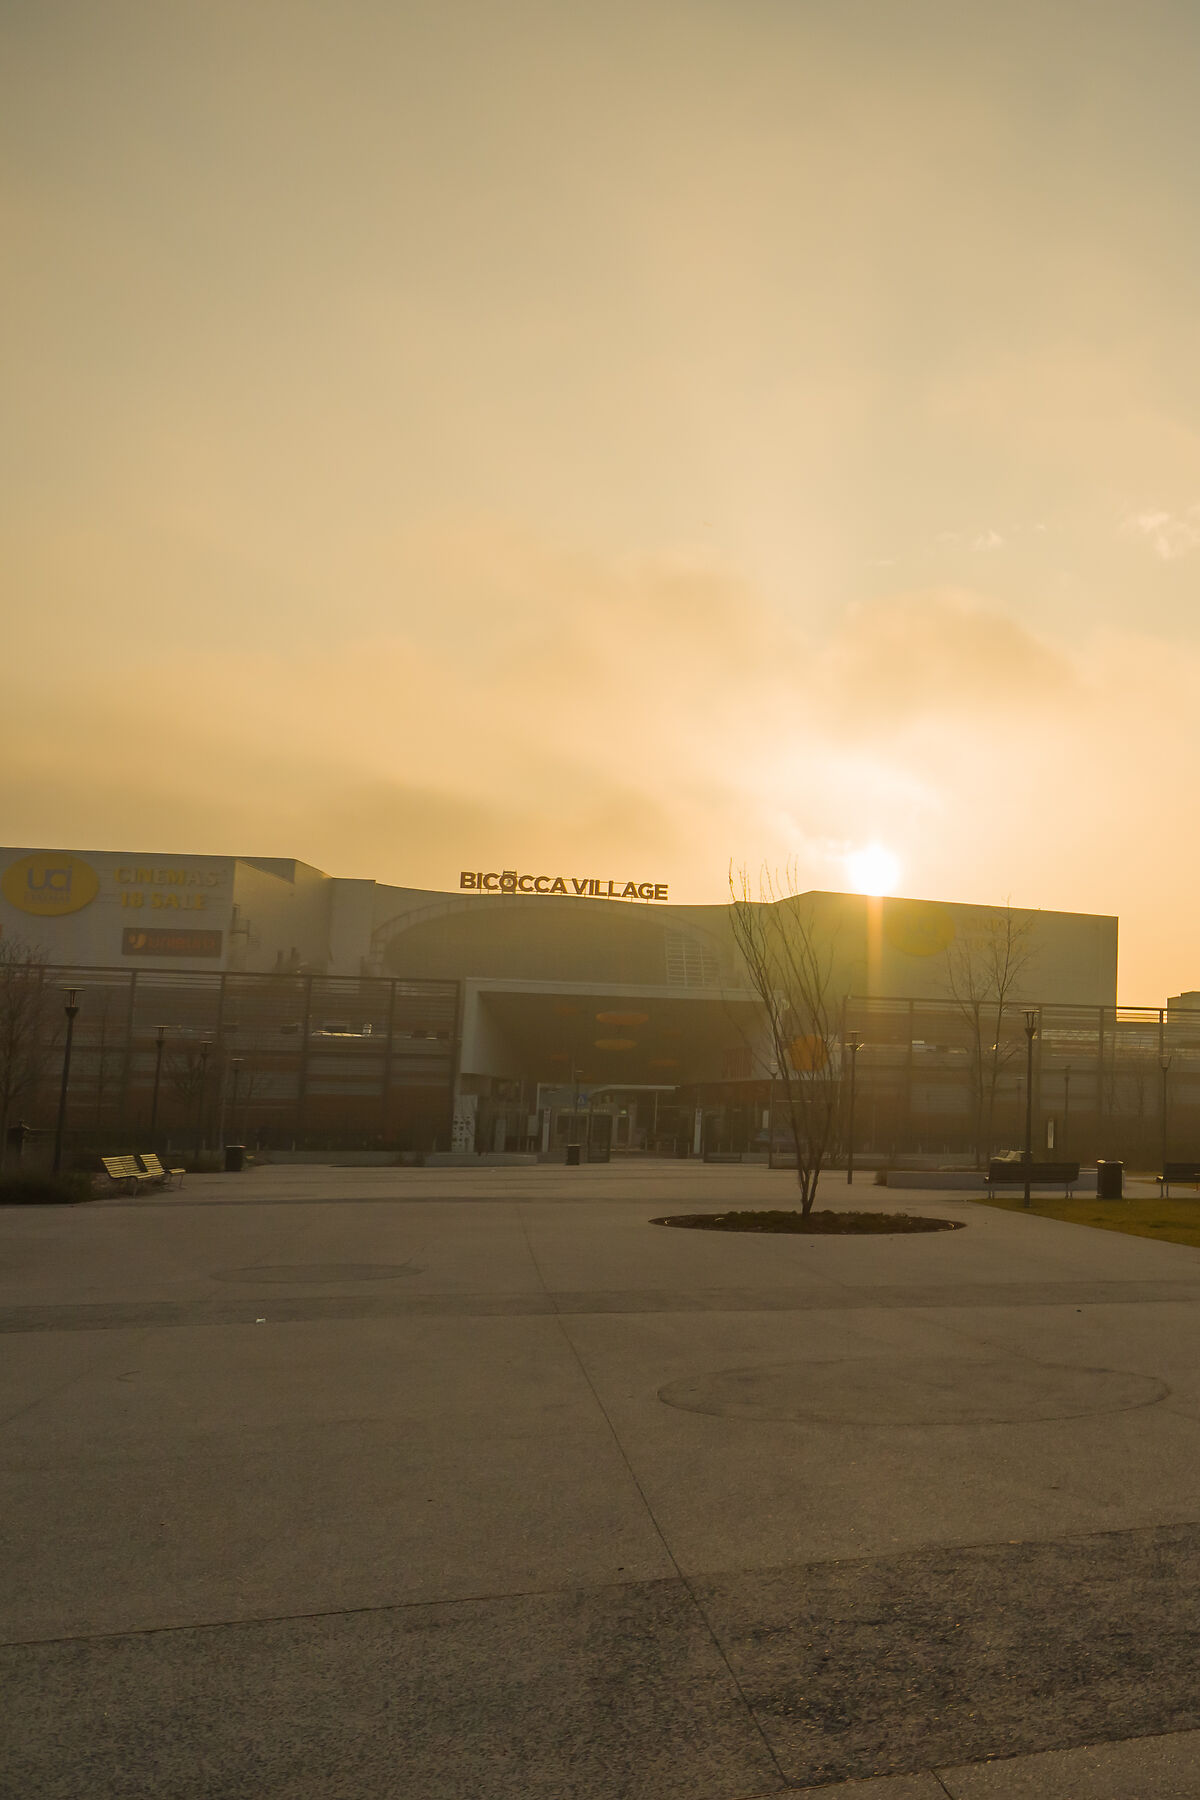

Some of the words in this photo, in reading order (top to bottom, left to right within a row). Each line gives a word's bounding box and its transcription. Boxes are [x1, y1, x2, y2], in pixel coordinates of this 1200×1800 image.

[114, 867, 218, 887] CINEMAS
[460, 871, 567, 893] BICOCCA
[572, 878, 668, 900] VILLAGE
[121, 891, 144, 908] 18
[151, 892, 208, 910] SALE
